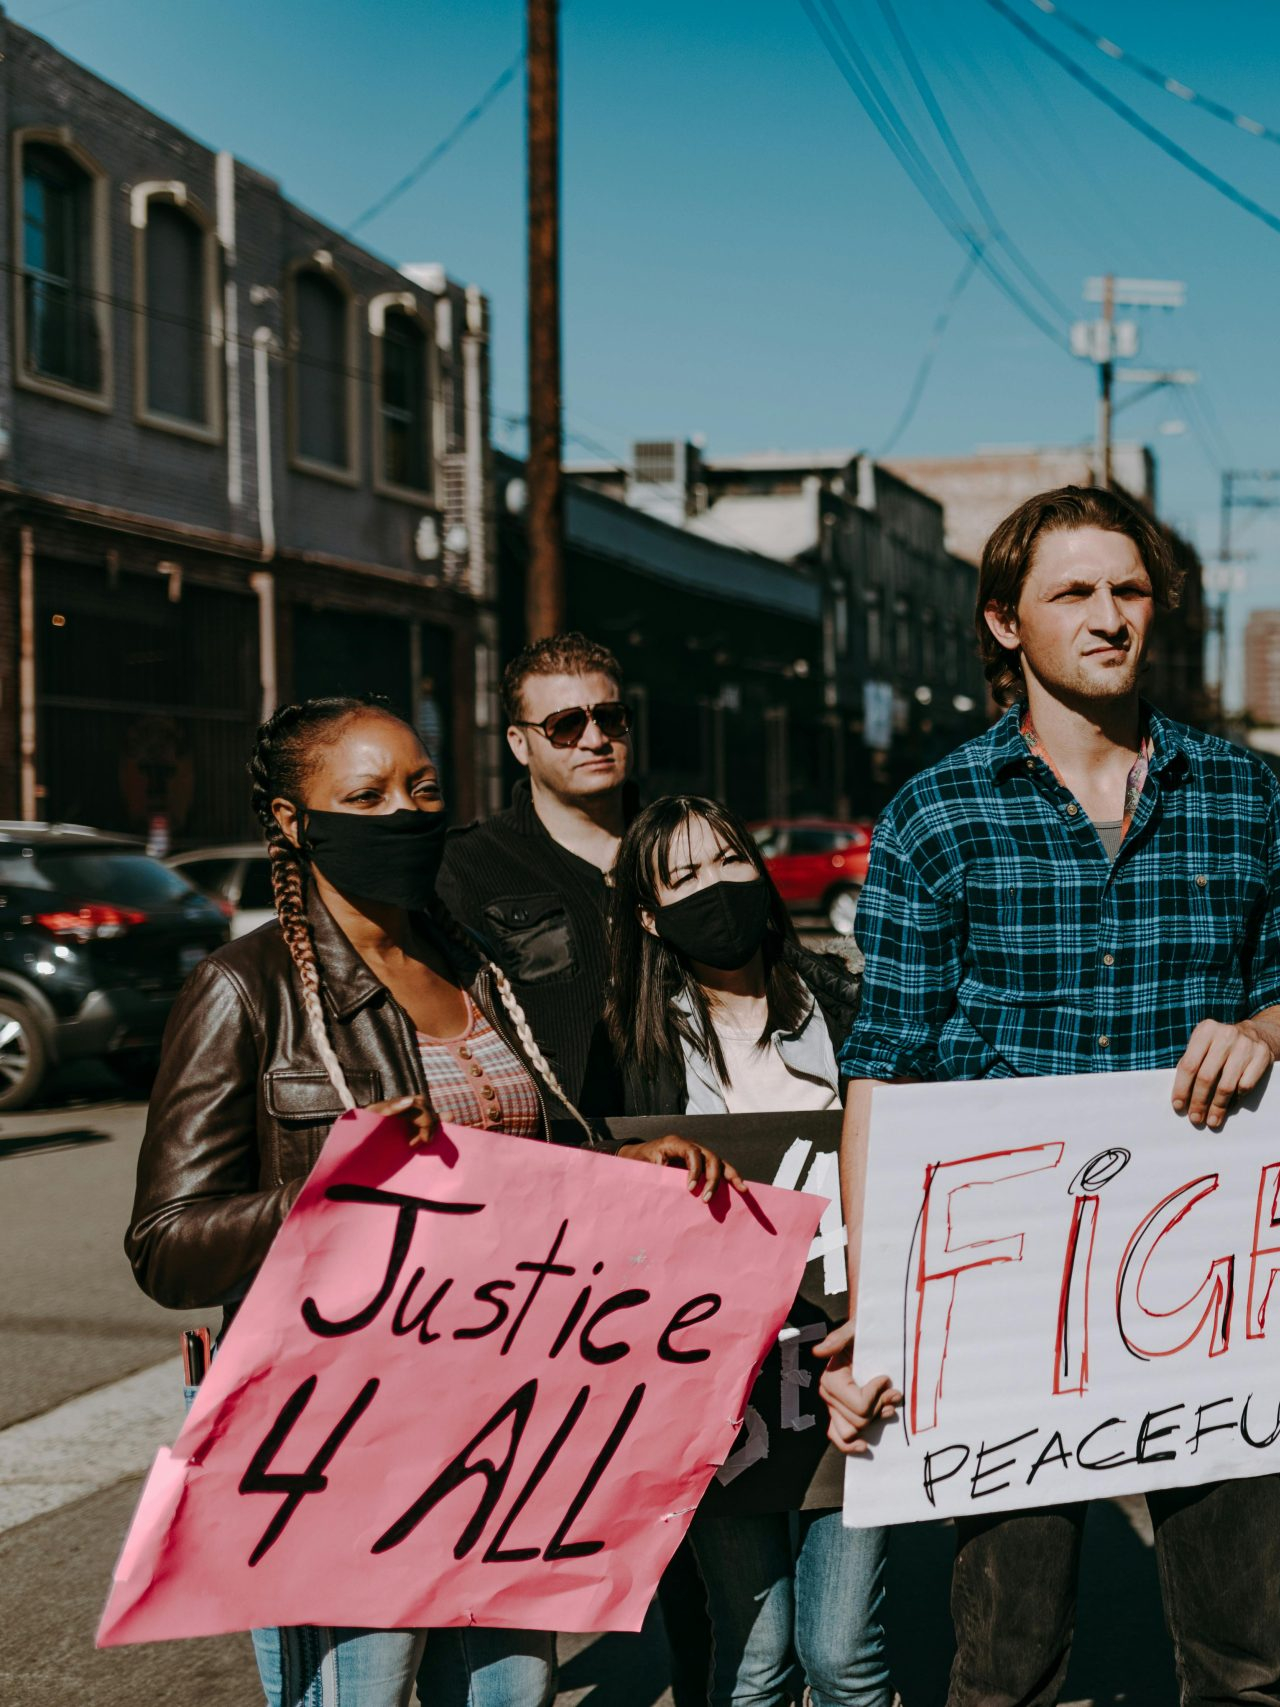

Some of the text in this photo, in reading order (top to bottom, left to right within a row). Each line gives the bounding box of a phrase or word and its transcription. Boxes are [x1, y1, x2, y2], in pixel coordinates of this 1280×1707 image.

[300, 1183, 722, 1365] Justice
[238, 1373, 381, 1567] 4
[370, 1377, 647, 1564] ALL
